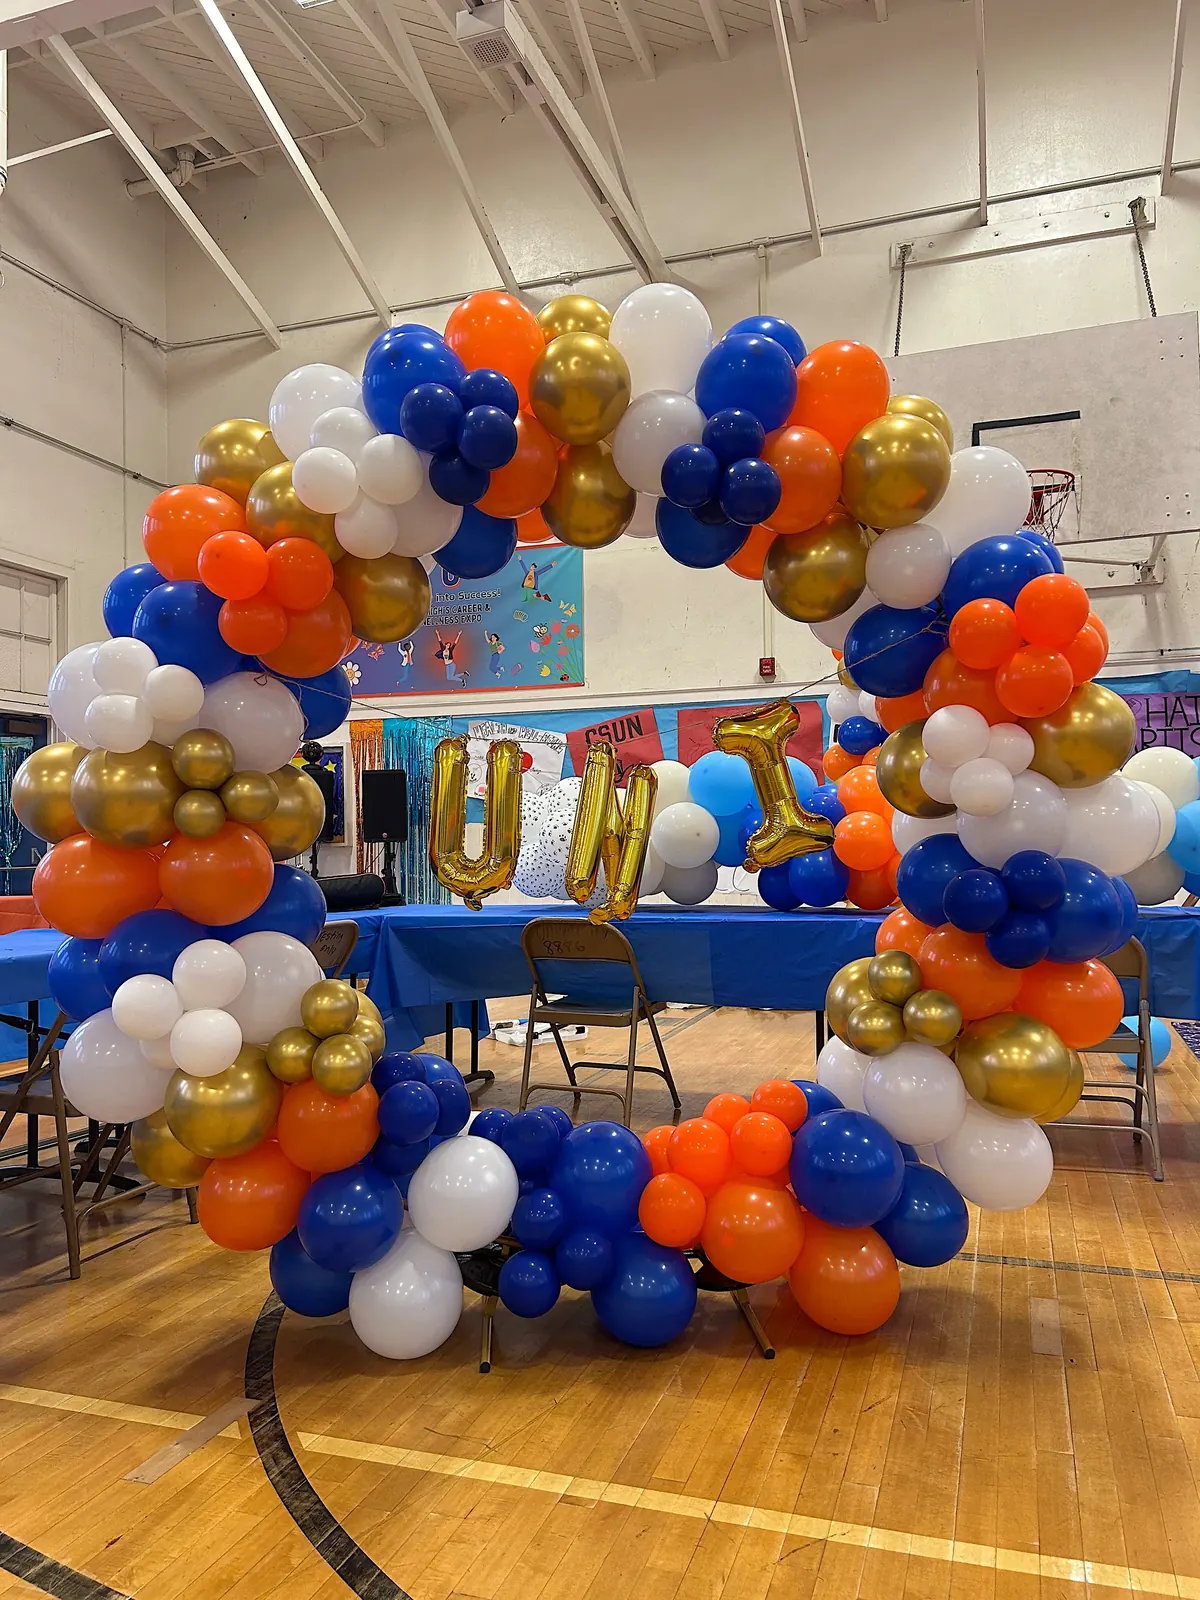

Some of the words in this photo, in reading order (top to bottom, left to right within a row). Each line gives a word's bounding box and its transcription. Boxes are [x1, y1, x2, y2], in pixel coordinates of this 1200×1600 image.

[436, 593, 455, 602] into
[451, 604, 482, 614] CAREER
[485, 603, 491, 612] &
[461, 614, 482, 623] EXPO
[585, 715, 643, 745] CSUN
